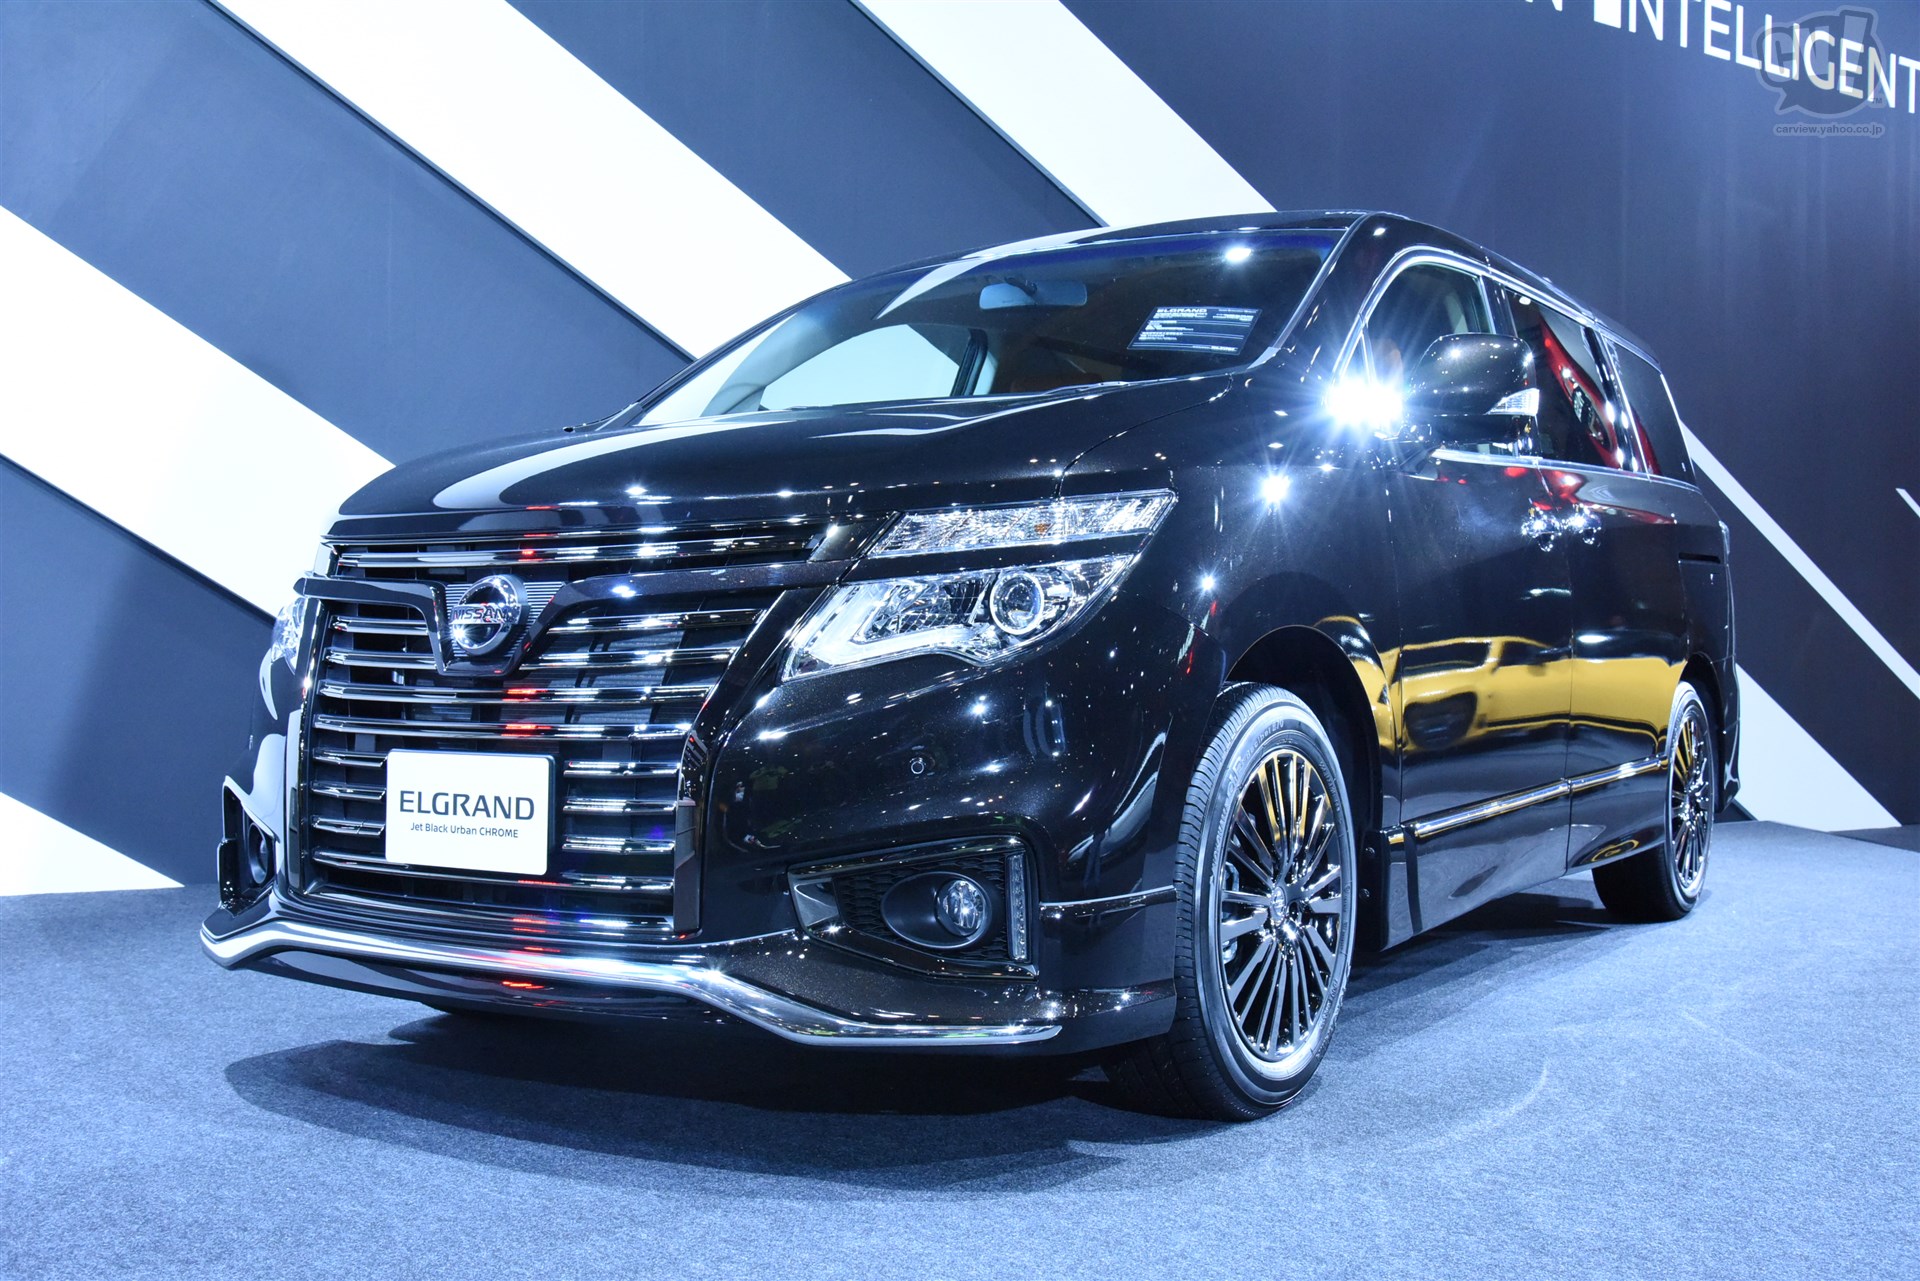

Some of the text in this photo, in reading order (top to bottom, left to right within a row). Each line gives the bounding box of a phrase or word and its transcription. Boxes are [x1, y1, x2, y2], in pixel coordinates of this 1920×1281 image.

[452, 606, 508, 620] NISSAN
[399, 790, 535, 820] ELGRAND
[410, 822, 519, 838] Jet Black Urban CHROME
